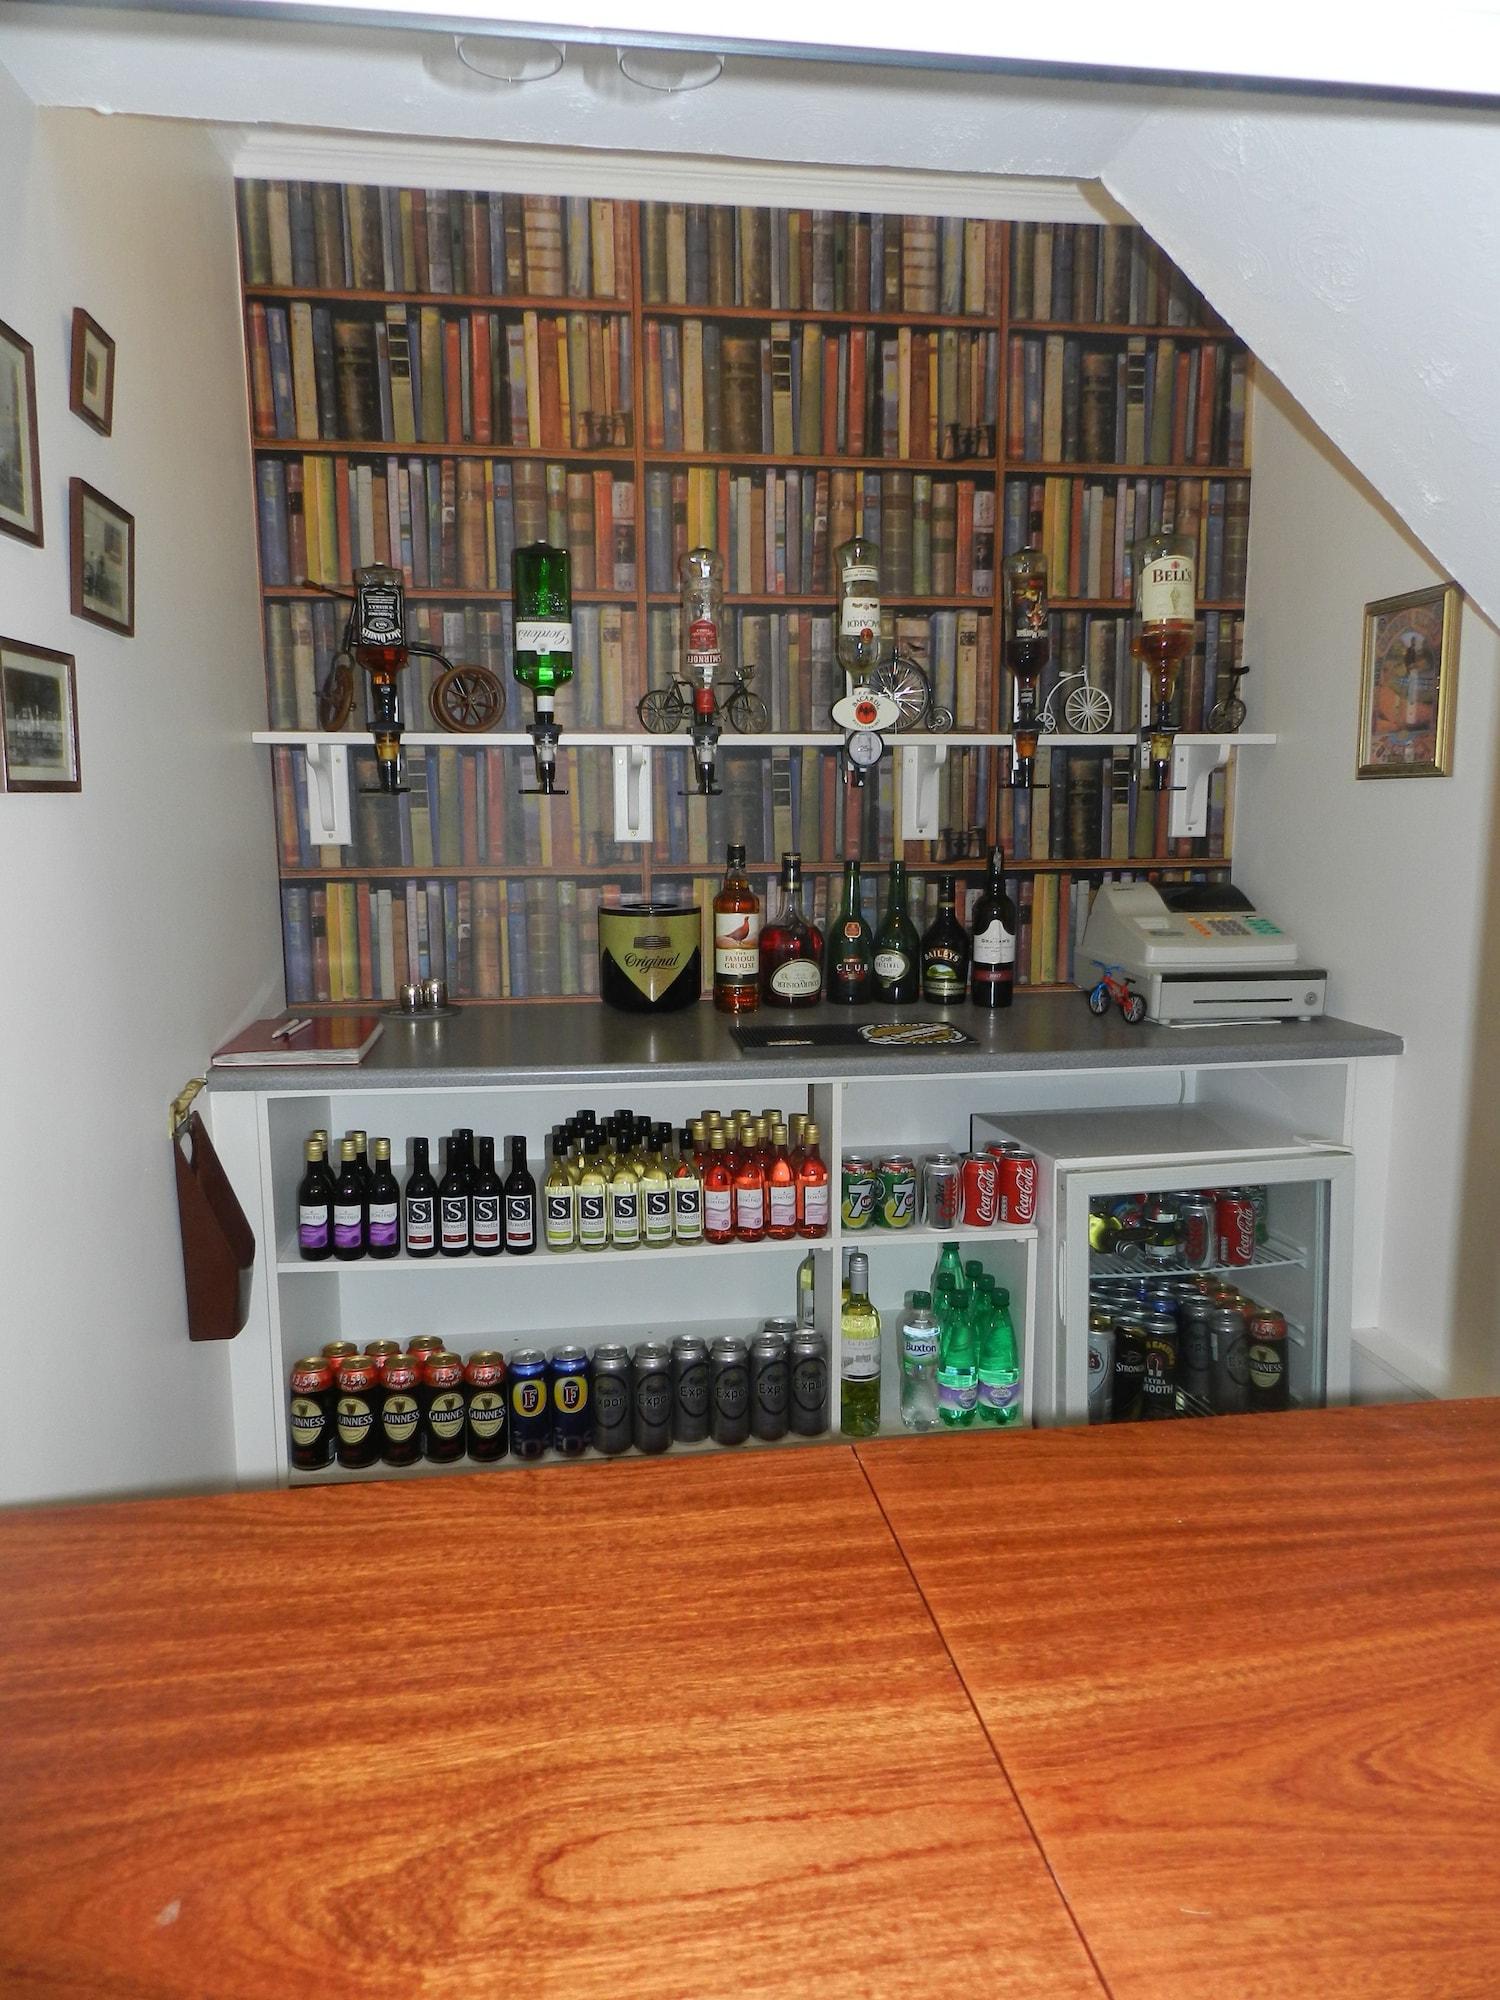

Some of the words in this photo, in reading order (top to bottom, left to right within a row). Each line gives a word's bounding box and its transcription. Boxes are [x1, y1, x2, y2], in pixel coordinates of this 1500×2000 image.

[1152, 568, 1192, 583] BELL'S
[385, 628, 402, 642] JACK
[517, 630, 570, 647] Gordon's
[624, 953, 681, 973] Original
[924, 948, 960, 962] BAILEYS
[412, 1202, 427, 1221] S
[447, 1202, 461, 1221] S
[478, 1201, 493, 1220] S
[511, 1200, 526, 1219] S
[551, 1199, 567, 1218] S
[584, 1199, 600, 1218] S
[618, 1197, 633, 1216] S
[651, 1194, 666, 1213] S
[681, 1193, 696, 1212] S
[906, 1341, 938, 1354] Buxton
[523, 1389, 538, 1408] F
[564, 1385, 578, 1404] F
[469, 1407, 506, 1419] GUINNESS
